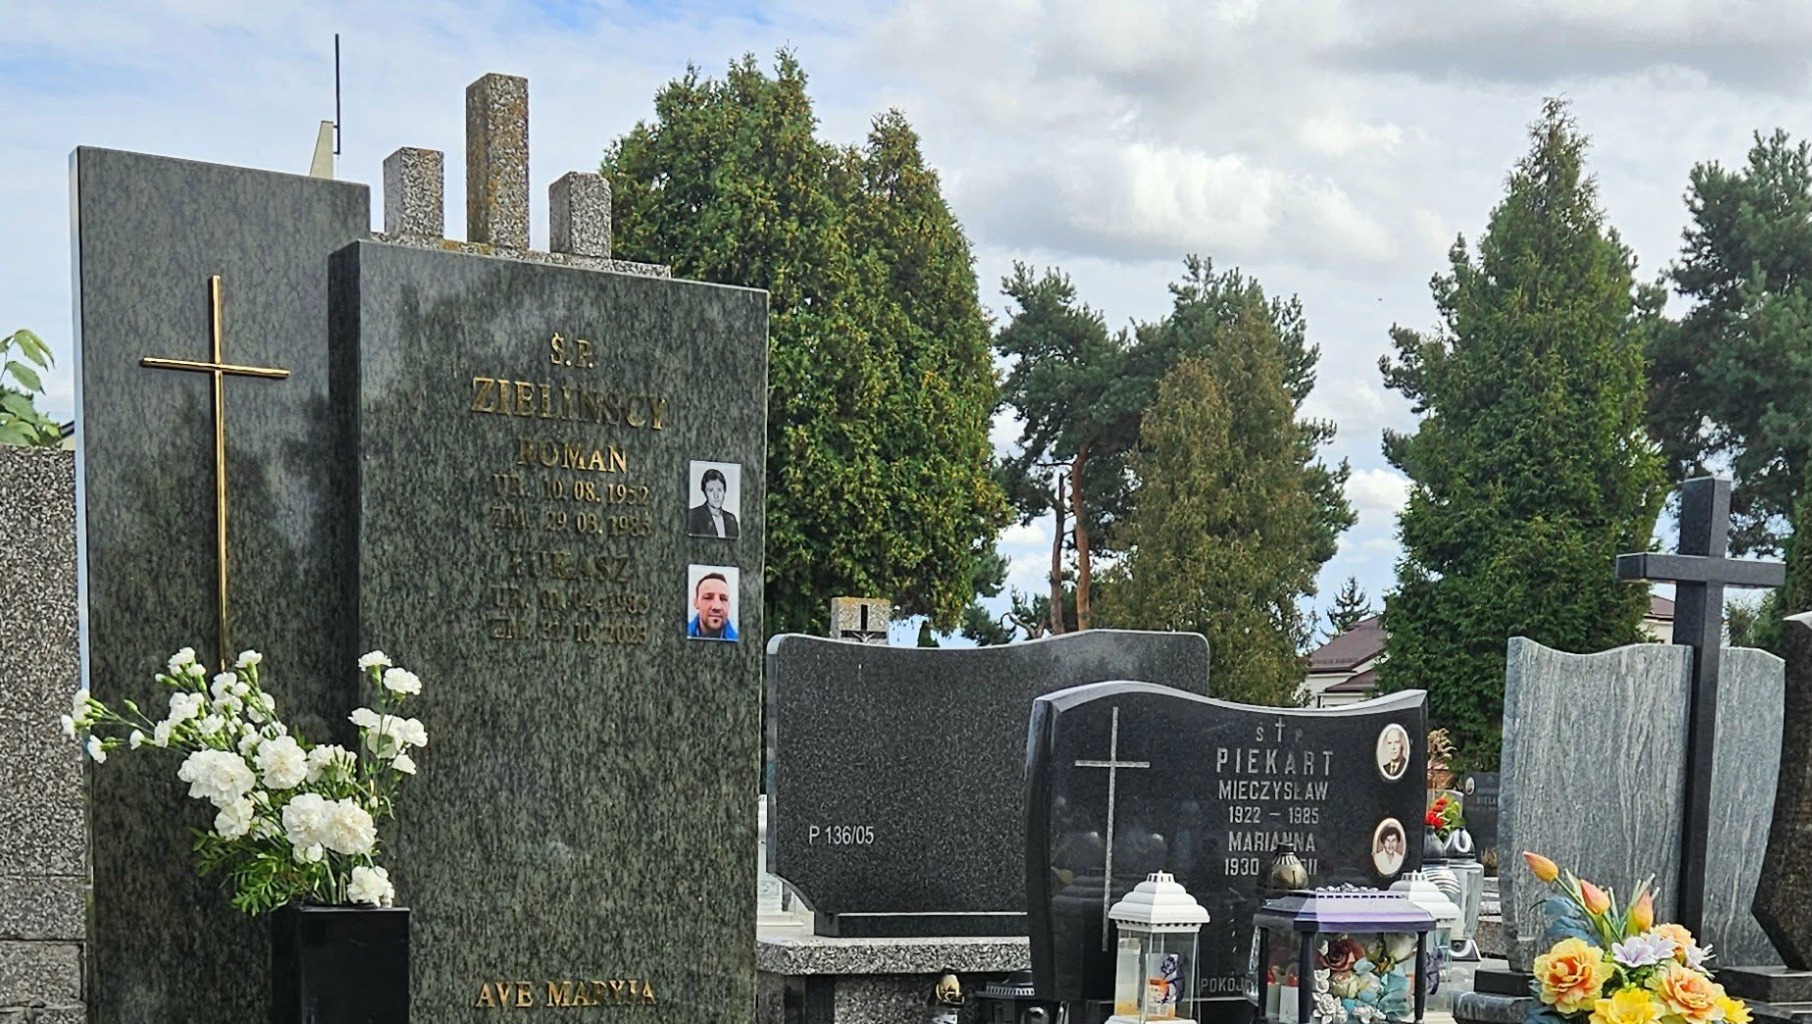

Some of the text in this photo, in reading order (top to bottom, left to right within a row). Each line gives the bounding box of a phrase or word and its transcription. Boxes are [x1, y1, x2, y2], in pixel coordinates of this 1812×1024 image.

[517, 434, 628, 474] ROMAN
[573, 479, 602, 503] 08.
[1216, 747, 1333, 776] PIEKART
[1229, 806, 1261, 824] 1922
[1289, 807, 1319, 824] 1985
[808, 825, 874, 845] P 136/05
[1225, 858, 1259, 876] 1930
[475, 981, 533, 1008] AVE
